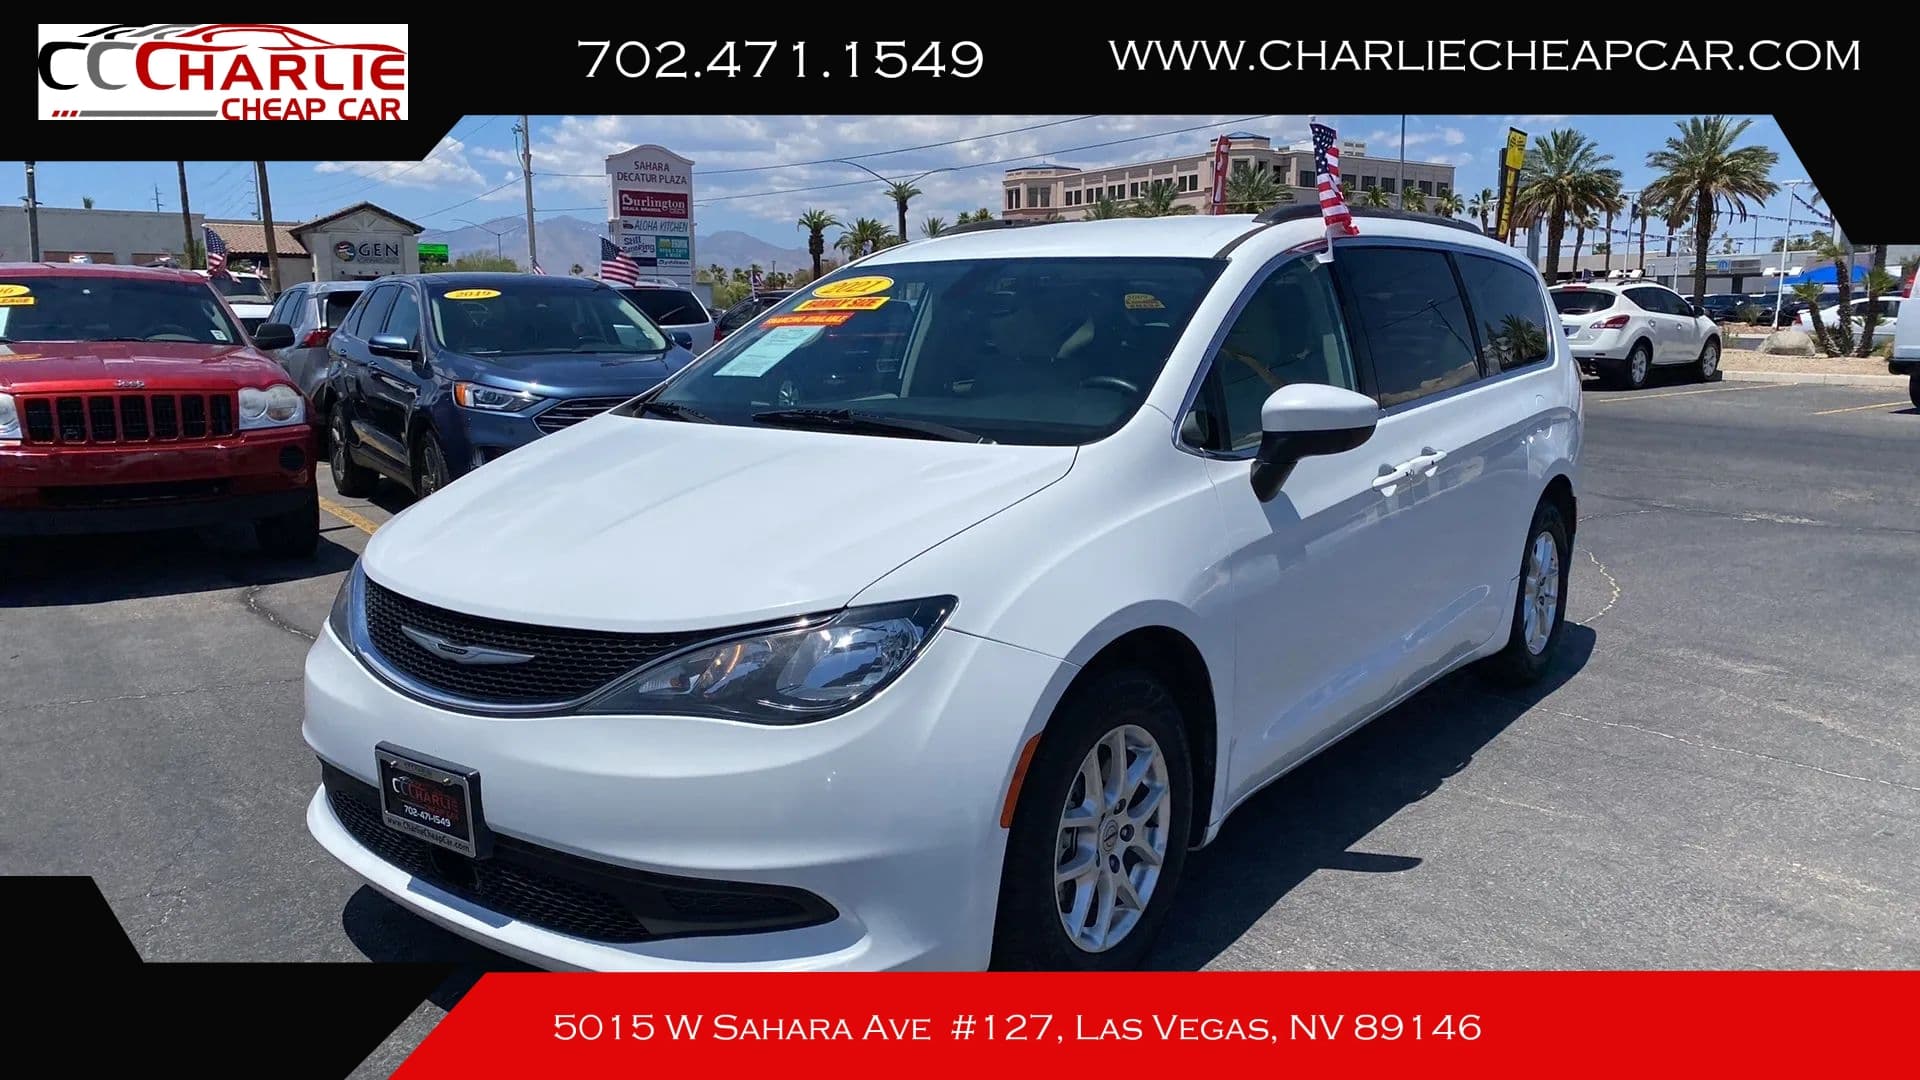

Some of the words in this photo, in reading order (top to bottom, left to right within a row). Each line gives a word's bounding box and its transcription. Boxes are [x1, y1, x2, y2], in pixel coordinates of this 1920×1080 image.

[634, 161, 670, 172] SAHARA
[617, 171, 657, 183] DECATUR
[659, 175, 687, 185] PLAZA
[622, 193, 685, 211] Burlington
[634, 220, 657, 231] ALOHA
[659, 221, 688, 233] KITCHEN
[358, 243, 399, 257] GEN
[403, 804, 451, 827] 702-471-1549
